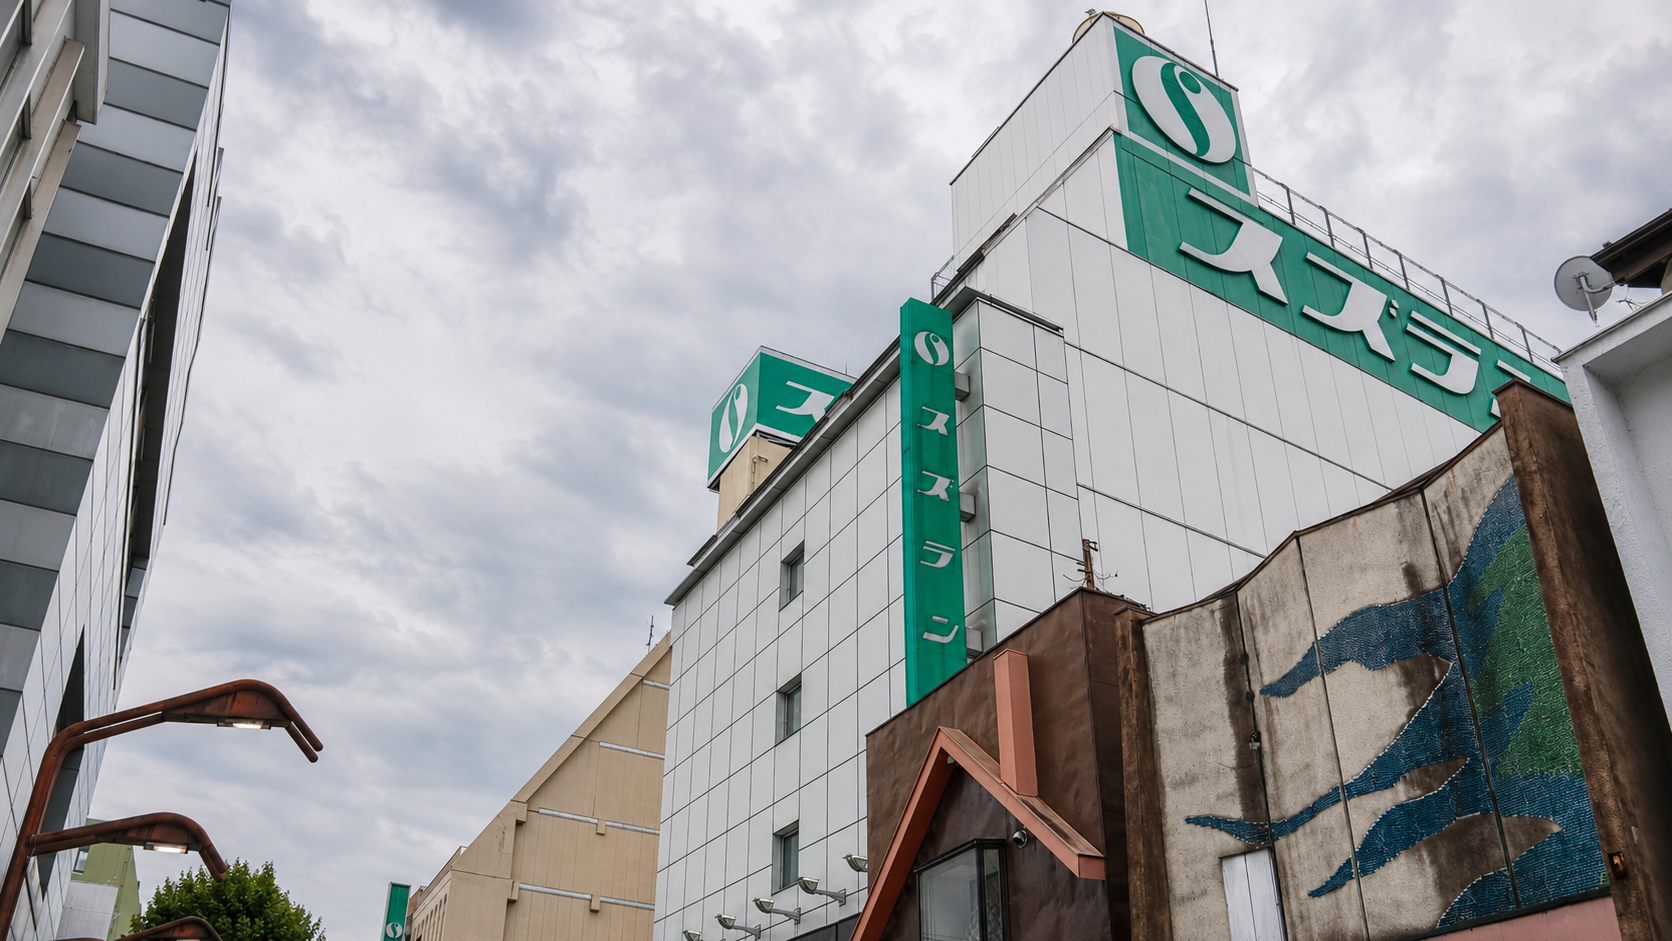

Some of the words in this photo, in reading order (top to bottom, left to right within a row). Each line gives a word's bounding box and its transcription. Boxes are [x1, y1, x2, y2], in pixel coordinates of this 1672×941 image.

[775, 380, 835, 423] ス
[916, 405, 959, 644] スズラン
